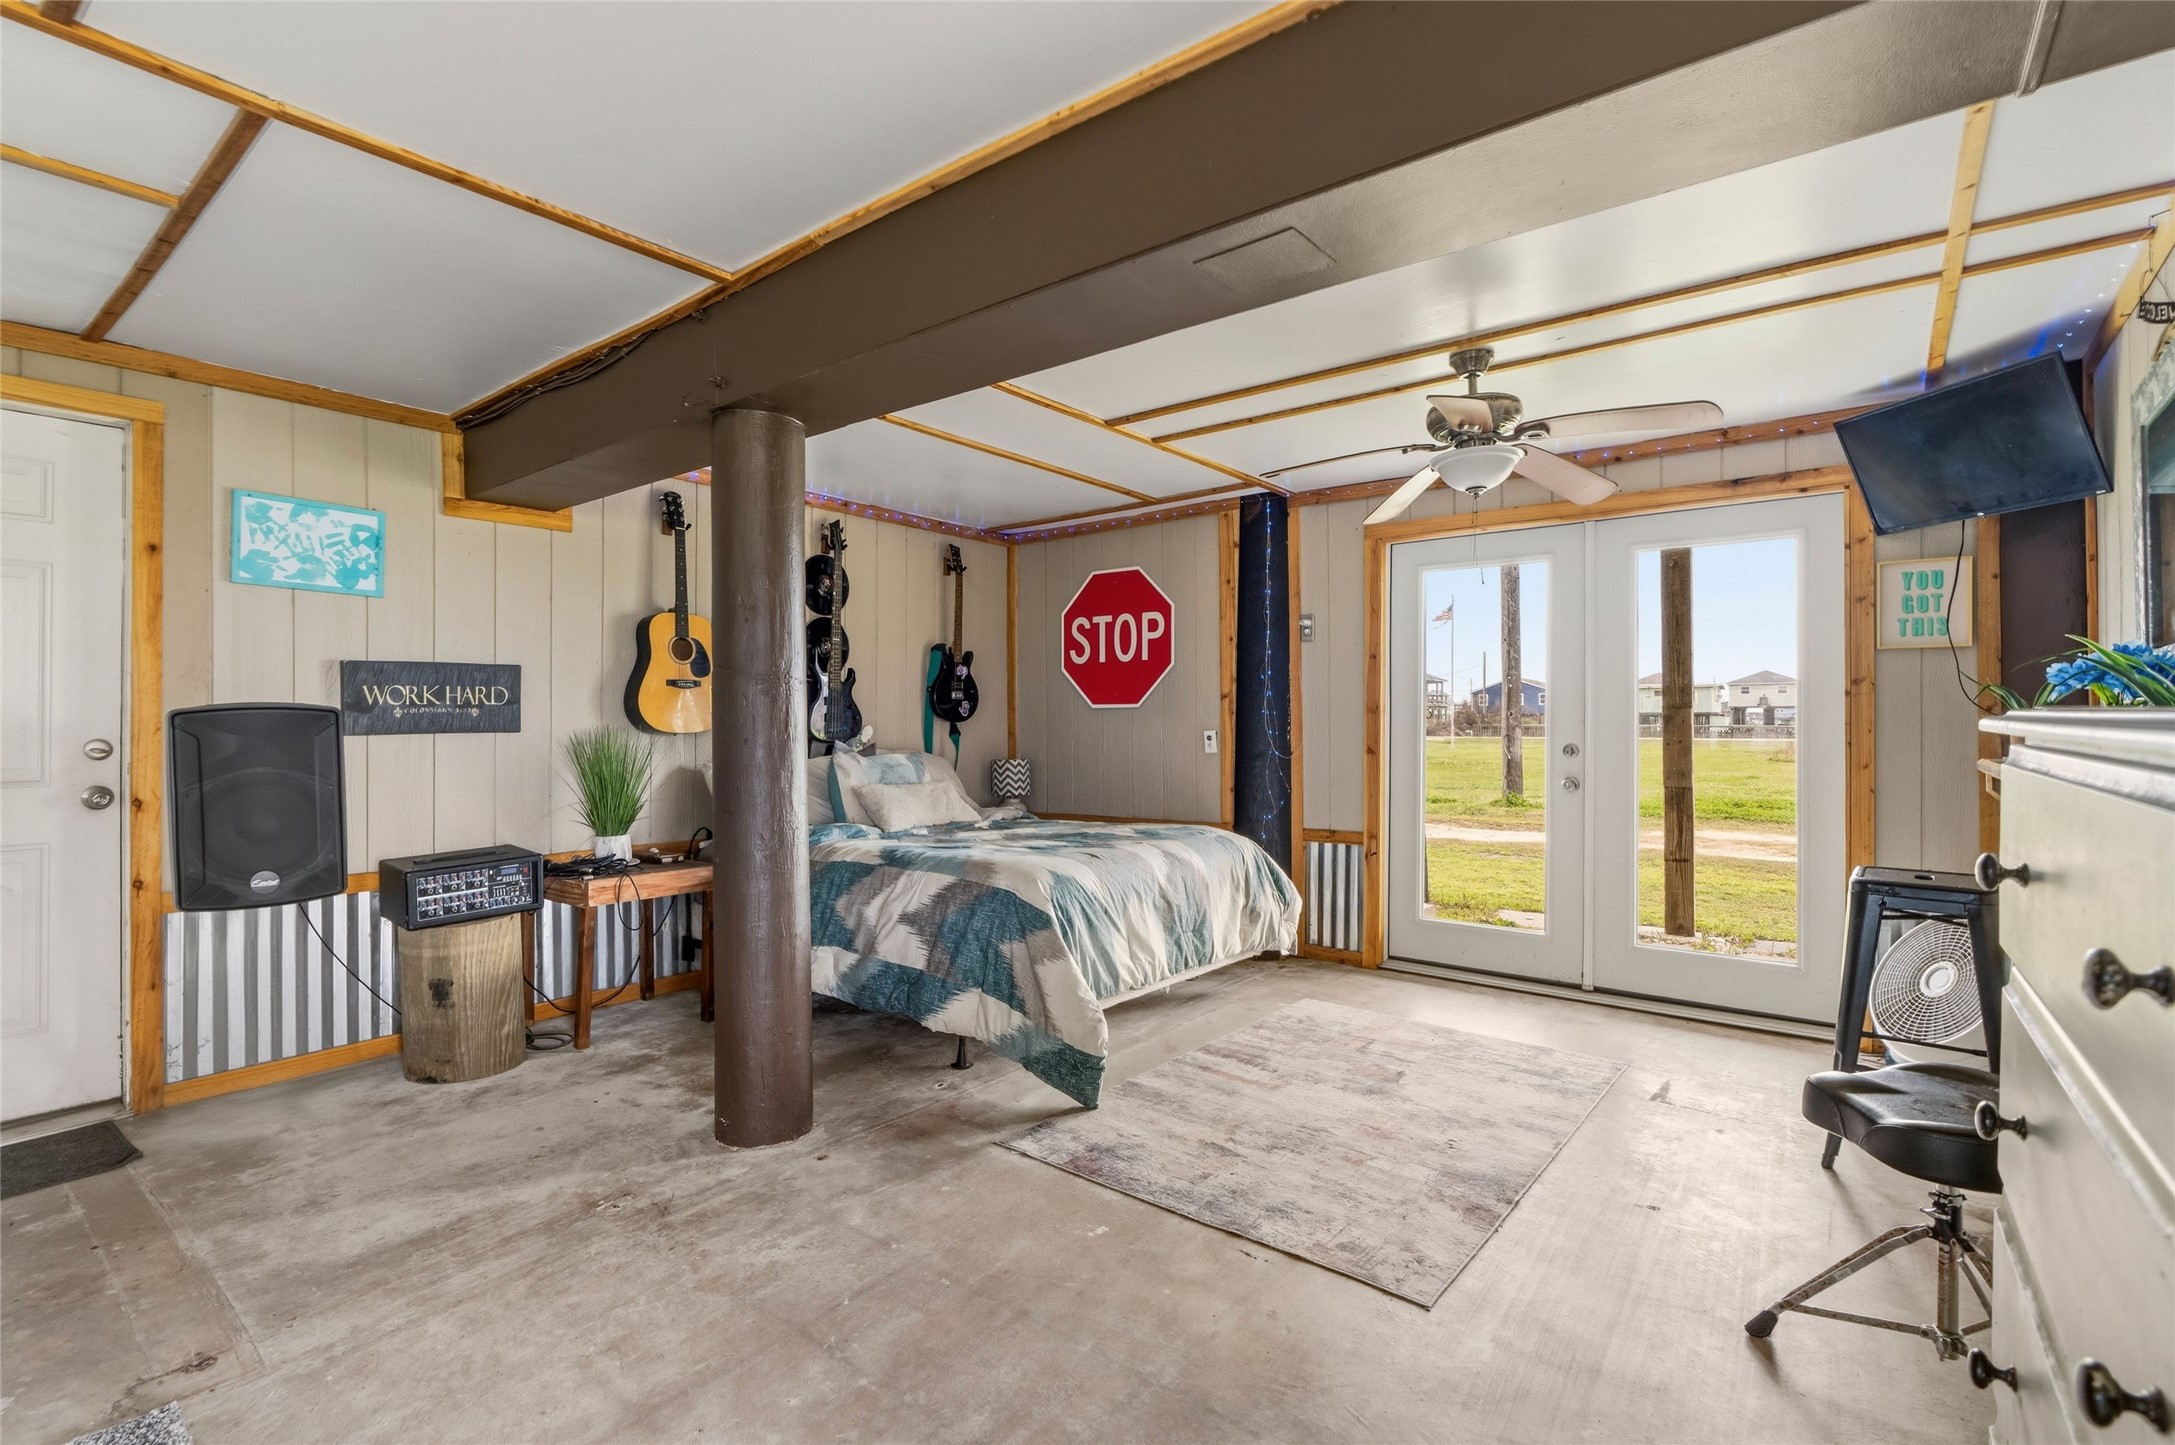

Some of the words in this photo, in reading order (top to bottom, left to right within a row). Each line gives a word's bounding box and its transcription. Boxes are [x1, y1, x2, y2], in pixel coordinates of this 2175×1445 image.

[1901, 569, 1944, 591] YOU
[1902, 593, 1943, 614] GOT
[1897, 616, 1948, 637] THIS
[1069, 611, 1165, 665] STOP
[362, 685, 441, 705] WORK
[446, 685, 509, 705] HARD
